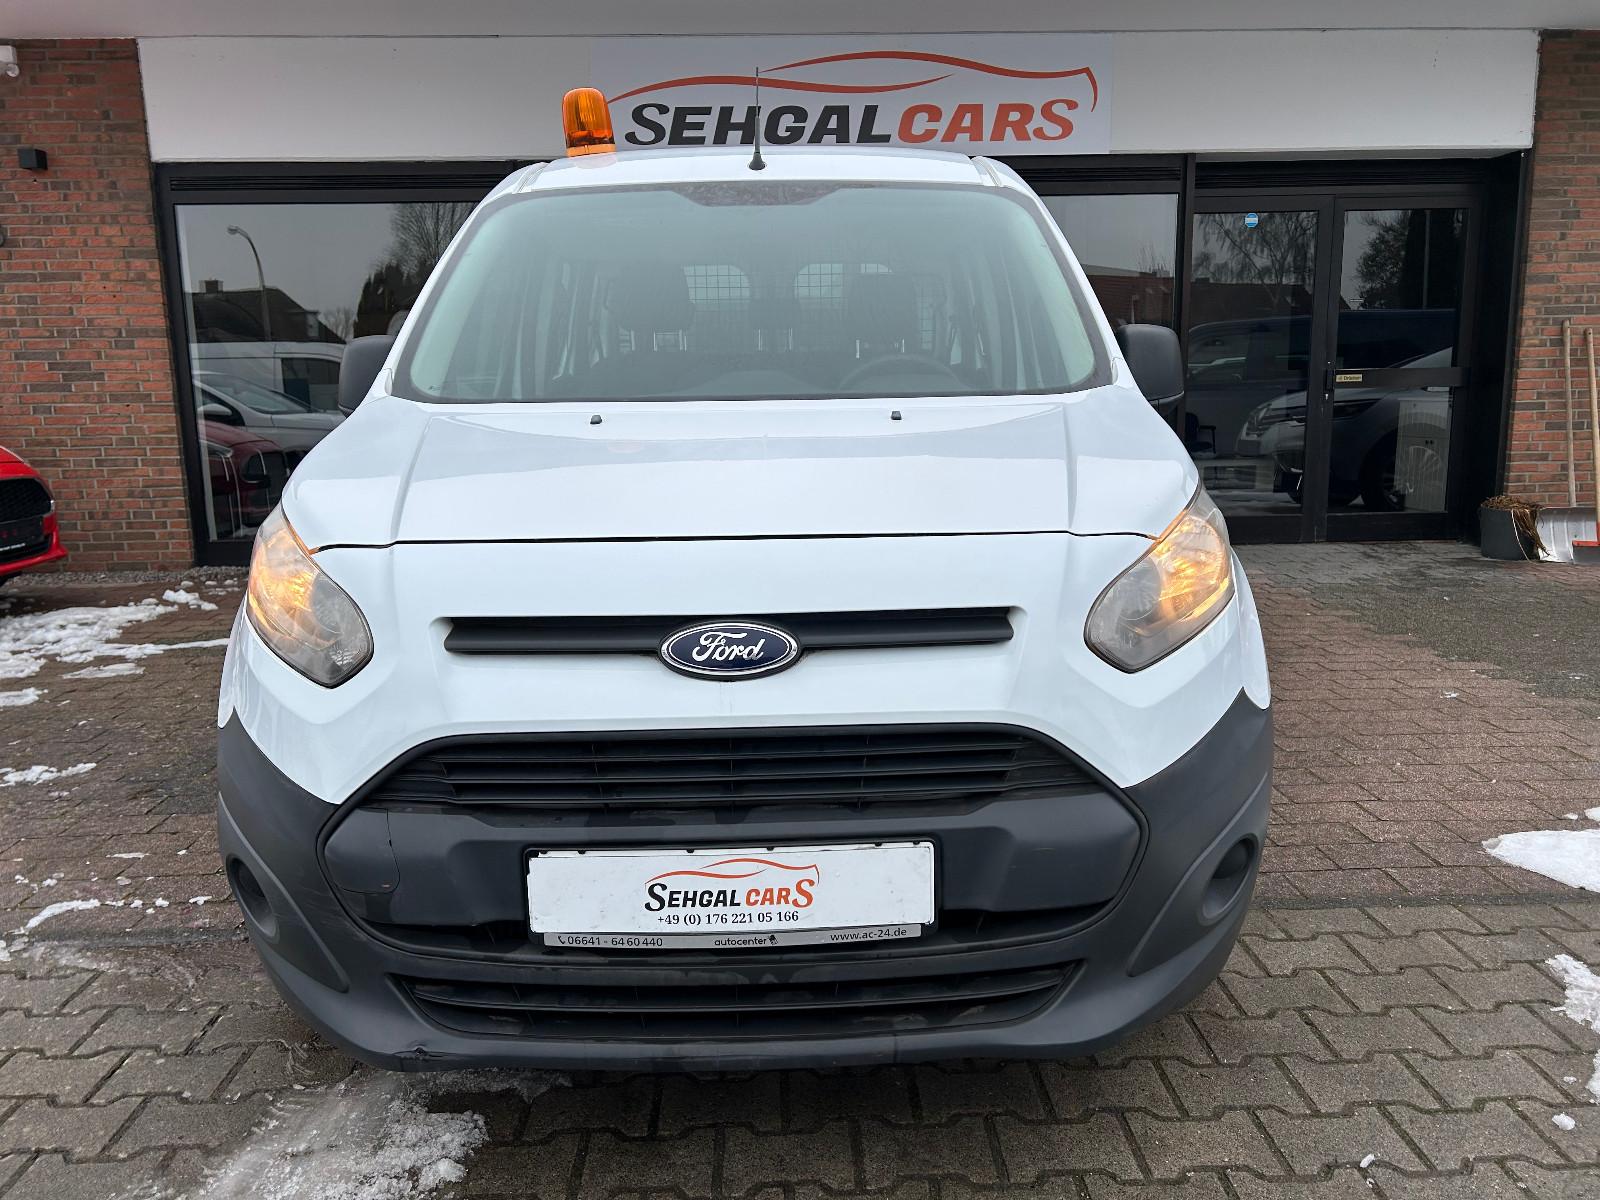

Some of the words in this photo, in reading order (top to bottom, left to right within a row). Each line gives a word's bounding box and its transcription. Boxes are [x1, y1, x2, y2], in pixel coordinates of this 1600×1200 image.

[624, 103, 891, 145] SEHGAL
[898, 98, 1079, 143] CARS
[692, 631, 766, 661] Ford
[644, 882, 741, 912] SEHGAL
[745, 878, 815, 909] CARS
[657, 914, 680, 925] +49
[683, 914, 701, 926] (0)
[705, 914, 728, 925] 176
[731, 913, 754, 924] 221
[757, 912, 773, 923] 05
[777, 911, 799, 922] 166
[567, 936, 601, 946] 06641
[714, 937, 767, 946] autocenter
[830, 928, 907, 941] www.ac-24.de
